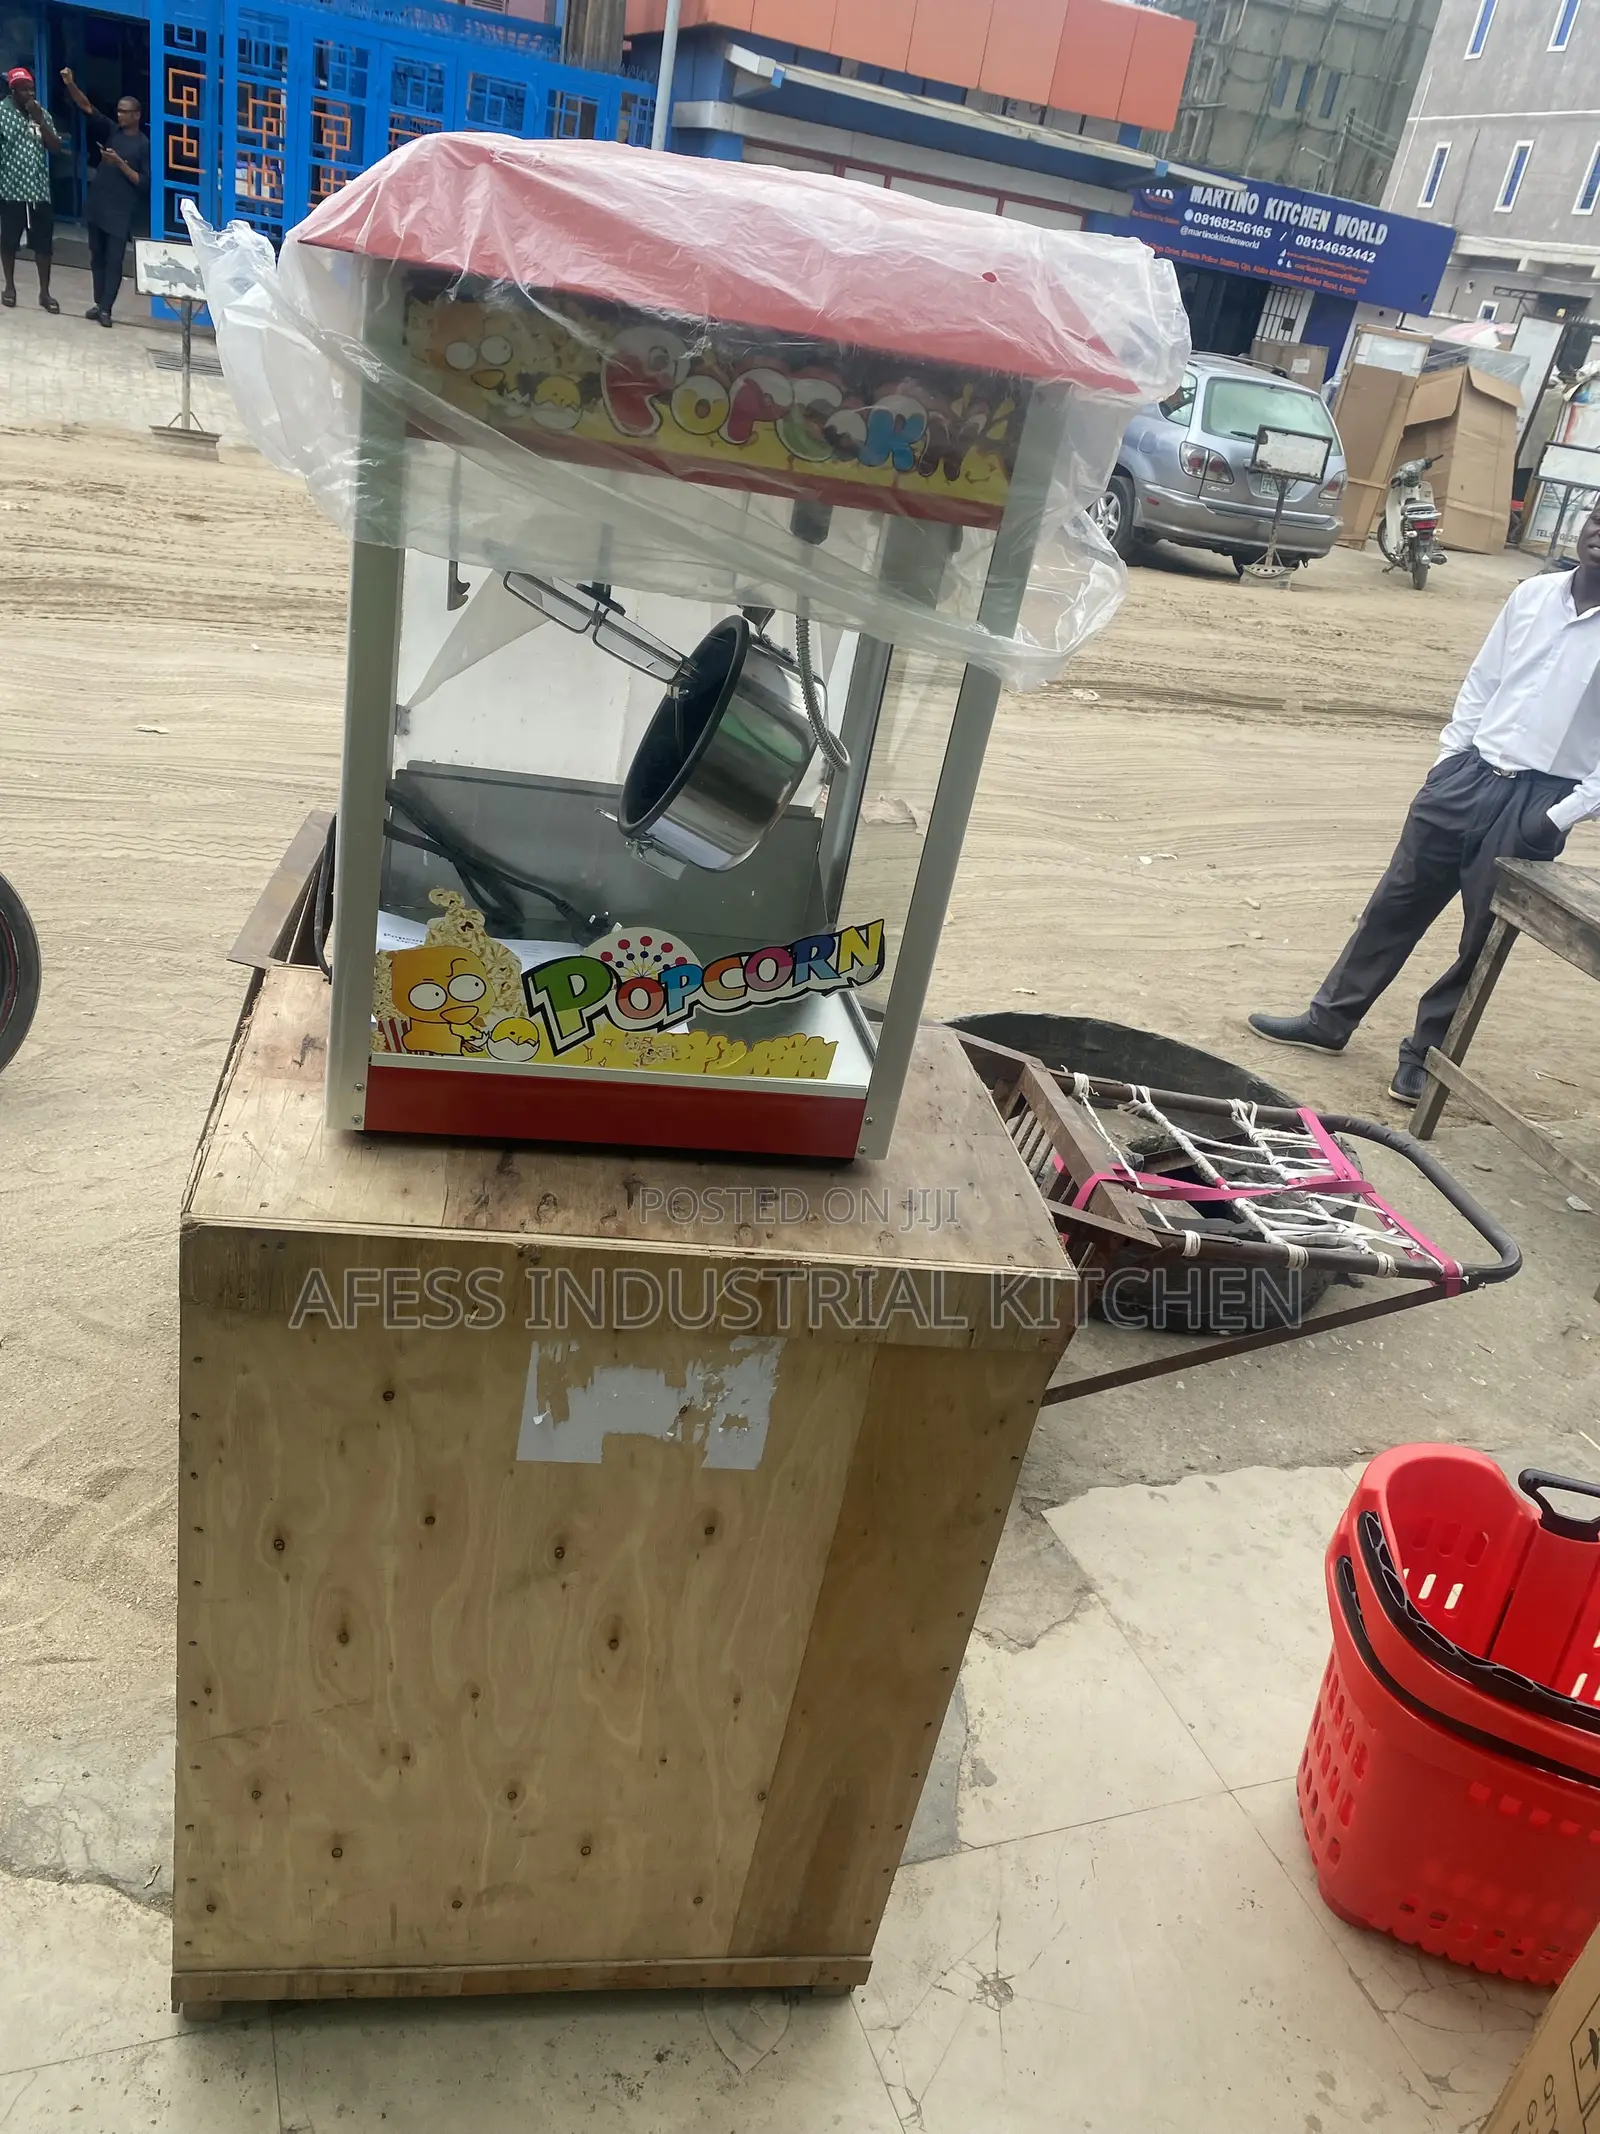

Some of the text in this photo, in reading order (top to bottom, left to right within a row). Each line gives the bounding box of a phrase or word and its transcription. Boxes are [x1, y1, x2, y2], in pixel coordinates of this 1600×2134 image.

[1180, 225, 1260, 249] @martinokitchenworld
[1189, 185, 1388, 246] MARTINO KITCHEN WORLD
[1193, 211, 1273, 239] 08168256165
[1295, 234, 1377, 263] 08134652442
[522, 918, 886, 1057] POPCORN
